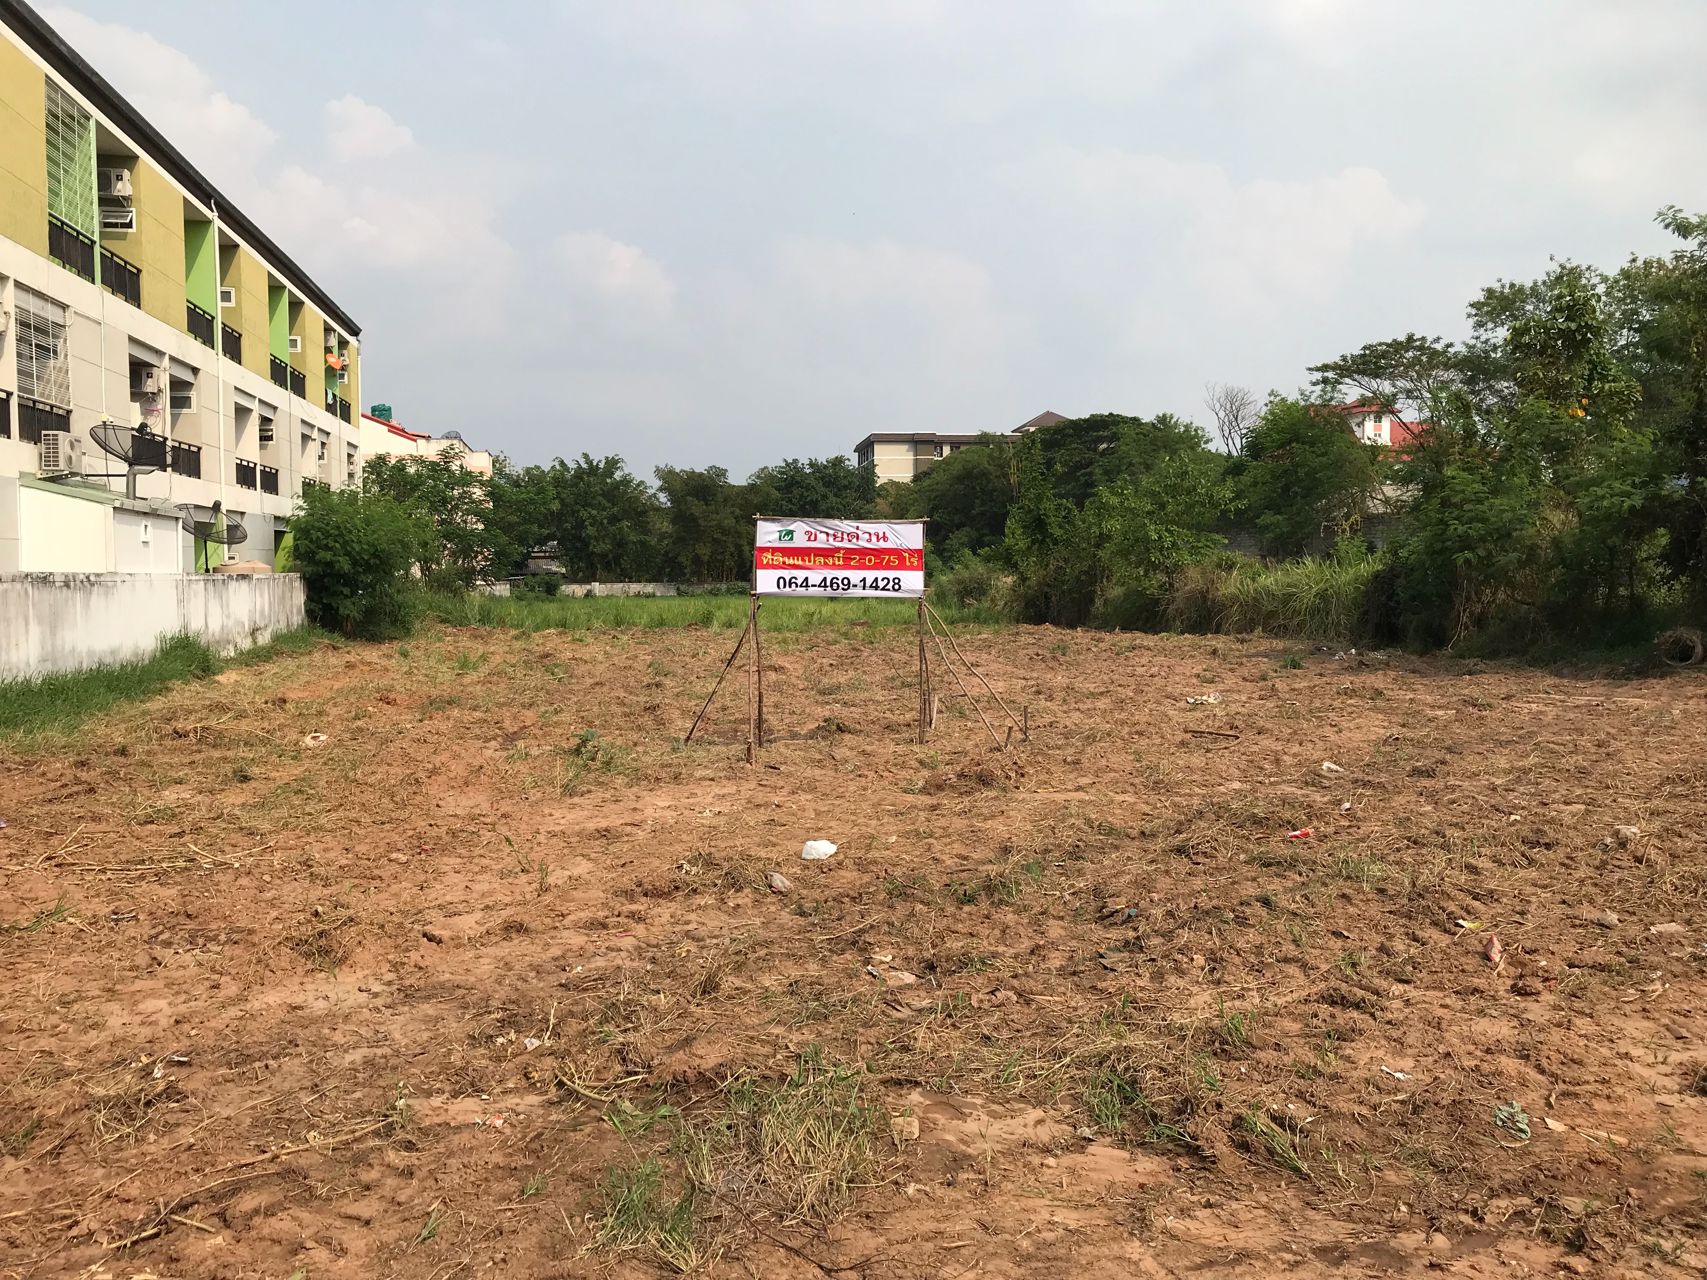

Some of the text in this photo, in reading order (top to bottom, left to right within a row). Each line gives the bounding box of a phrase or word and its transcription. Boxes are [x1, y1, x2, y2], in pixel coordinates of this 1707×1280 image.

[804, 525, 889, 543] ขายด่วน
[761, 549, 919, 567] ที่ดินแปลงนี้ 2-0-75 ไร่
[776, 576, 902, 592] 064-469-1428
